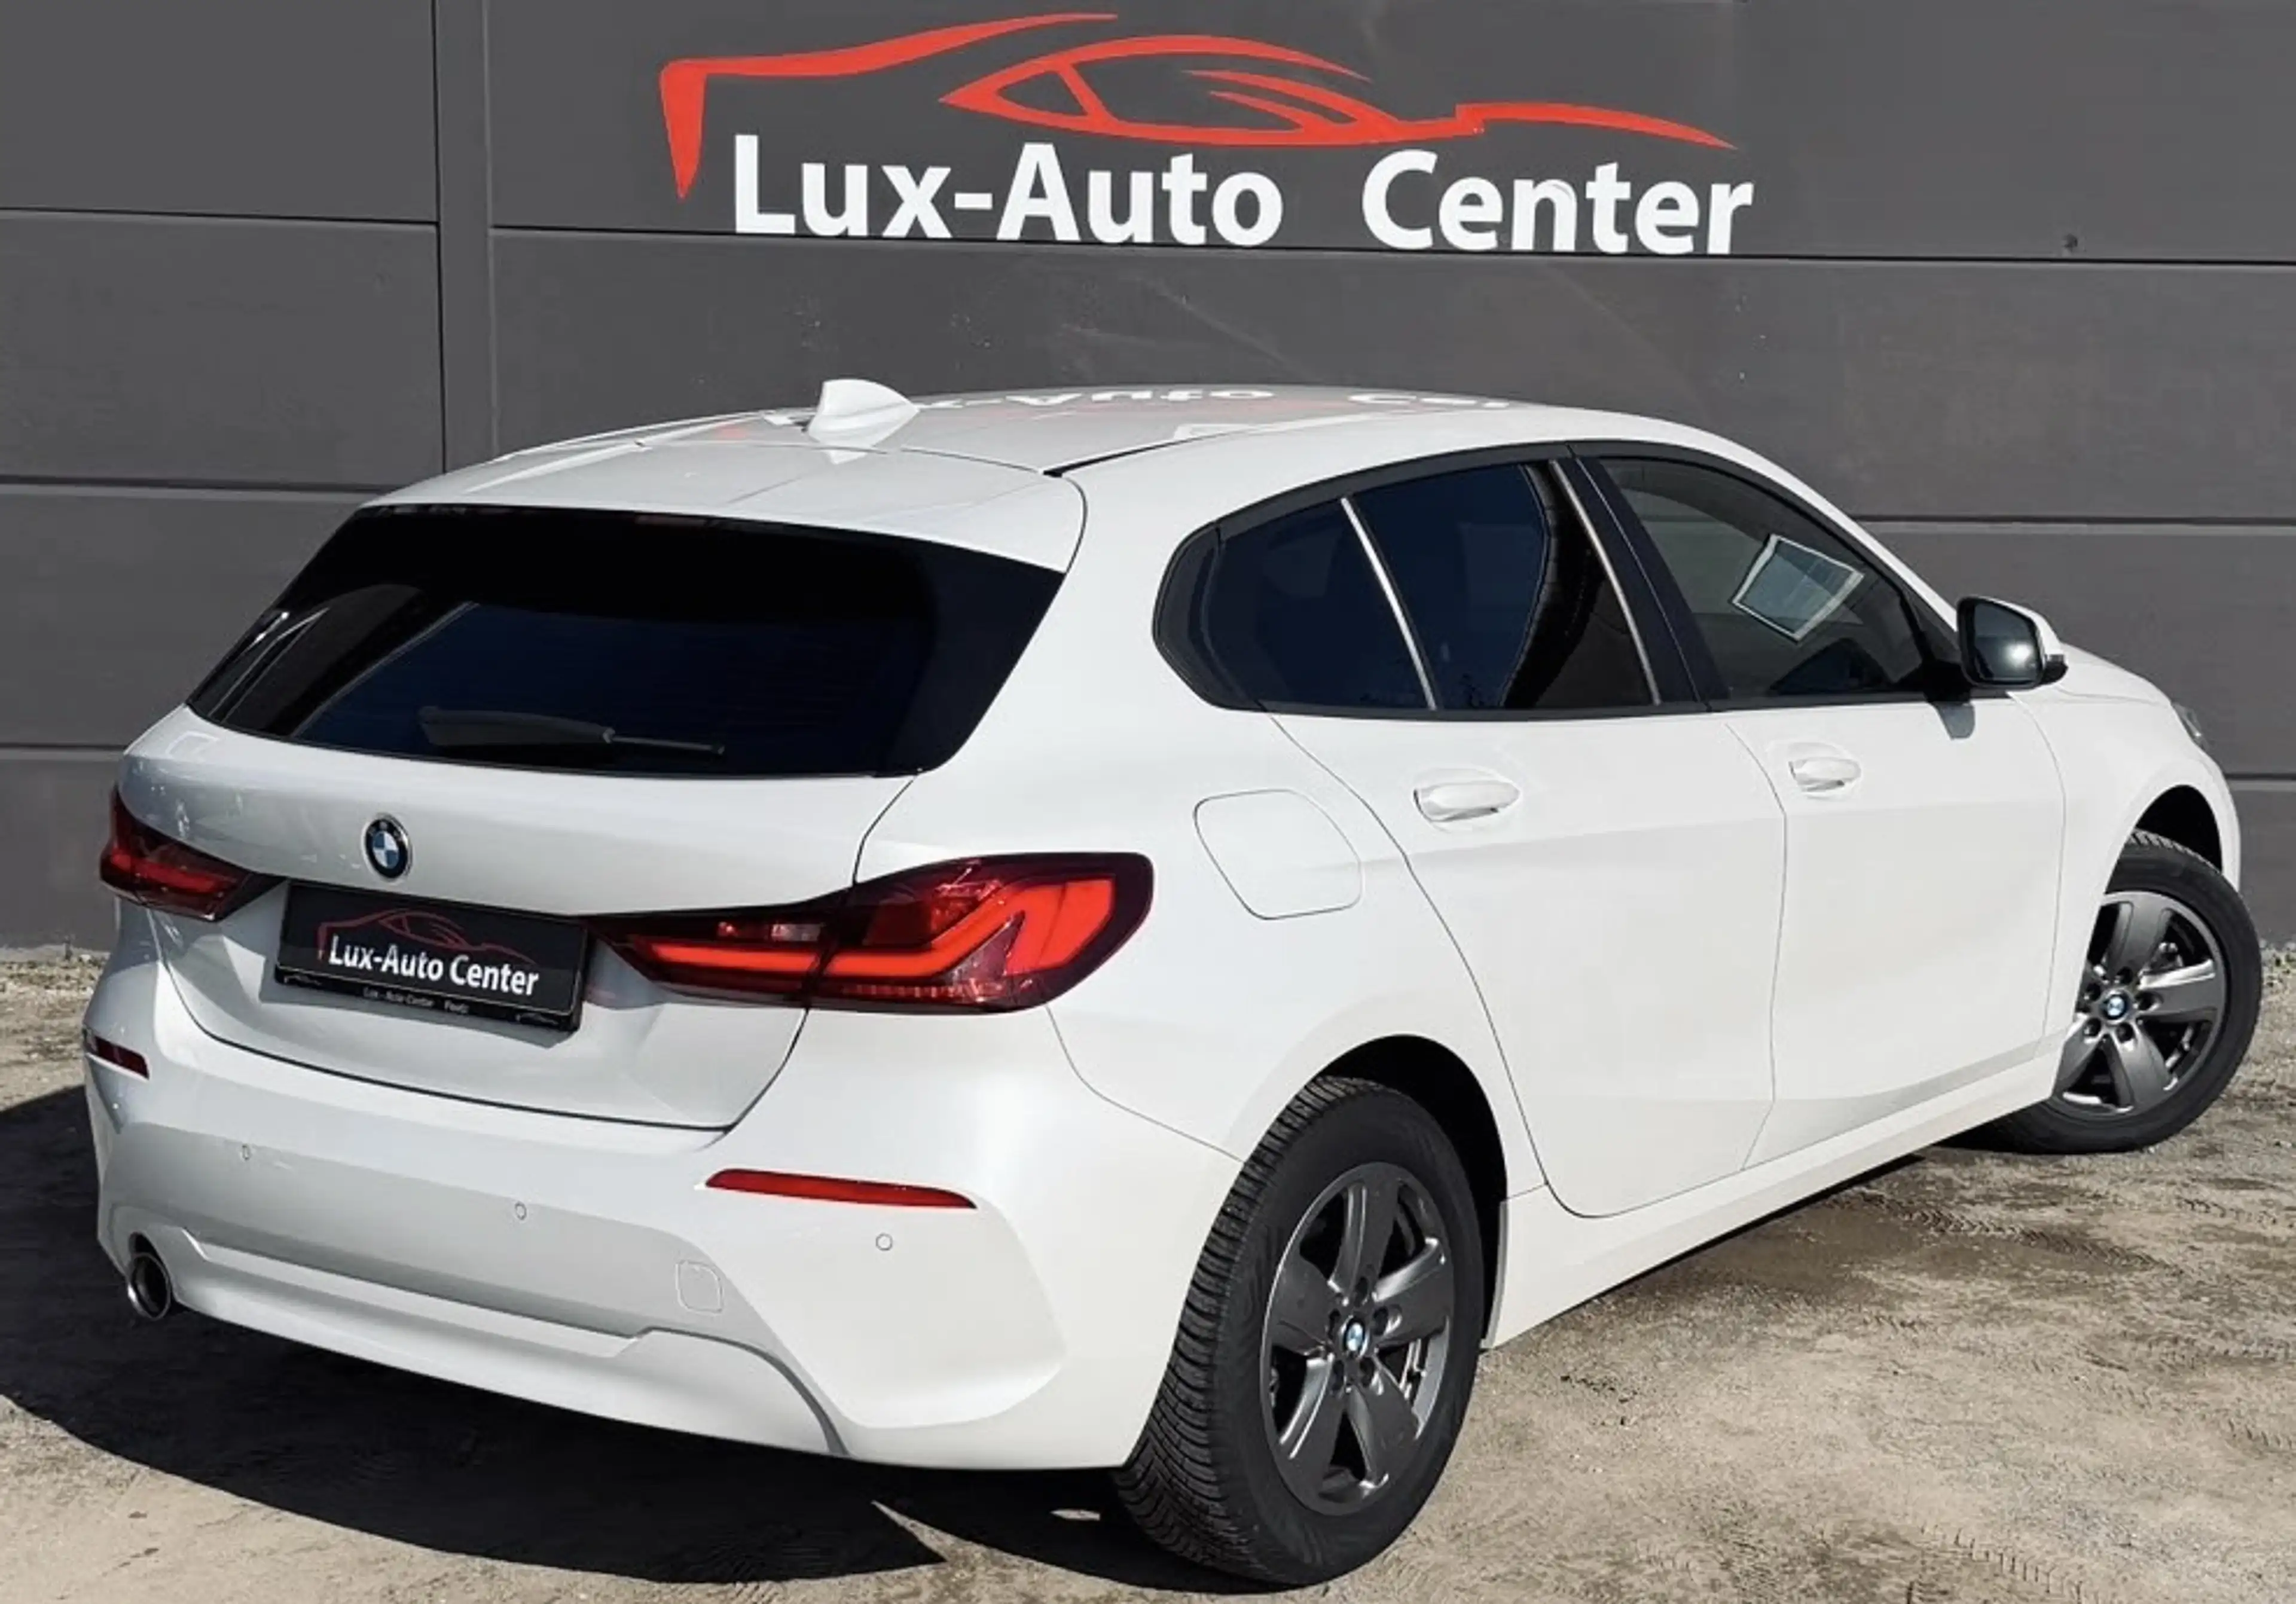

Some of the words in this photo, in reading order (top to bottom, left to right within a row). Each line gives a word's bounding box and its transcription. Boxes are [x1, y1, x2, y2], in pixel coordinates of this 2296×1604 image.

[734, 134, 1284, 247] Lux-Auto
[1361, 149, 1755, 255] Center
[328, 934, 444, 982] Lux-Auto
[449, 954, 540, 997] Center
